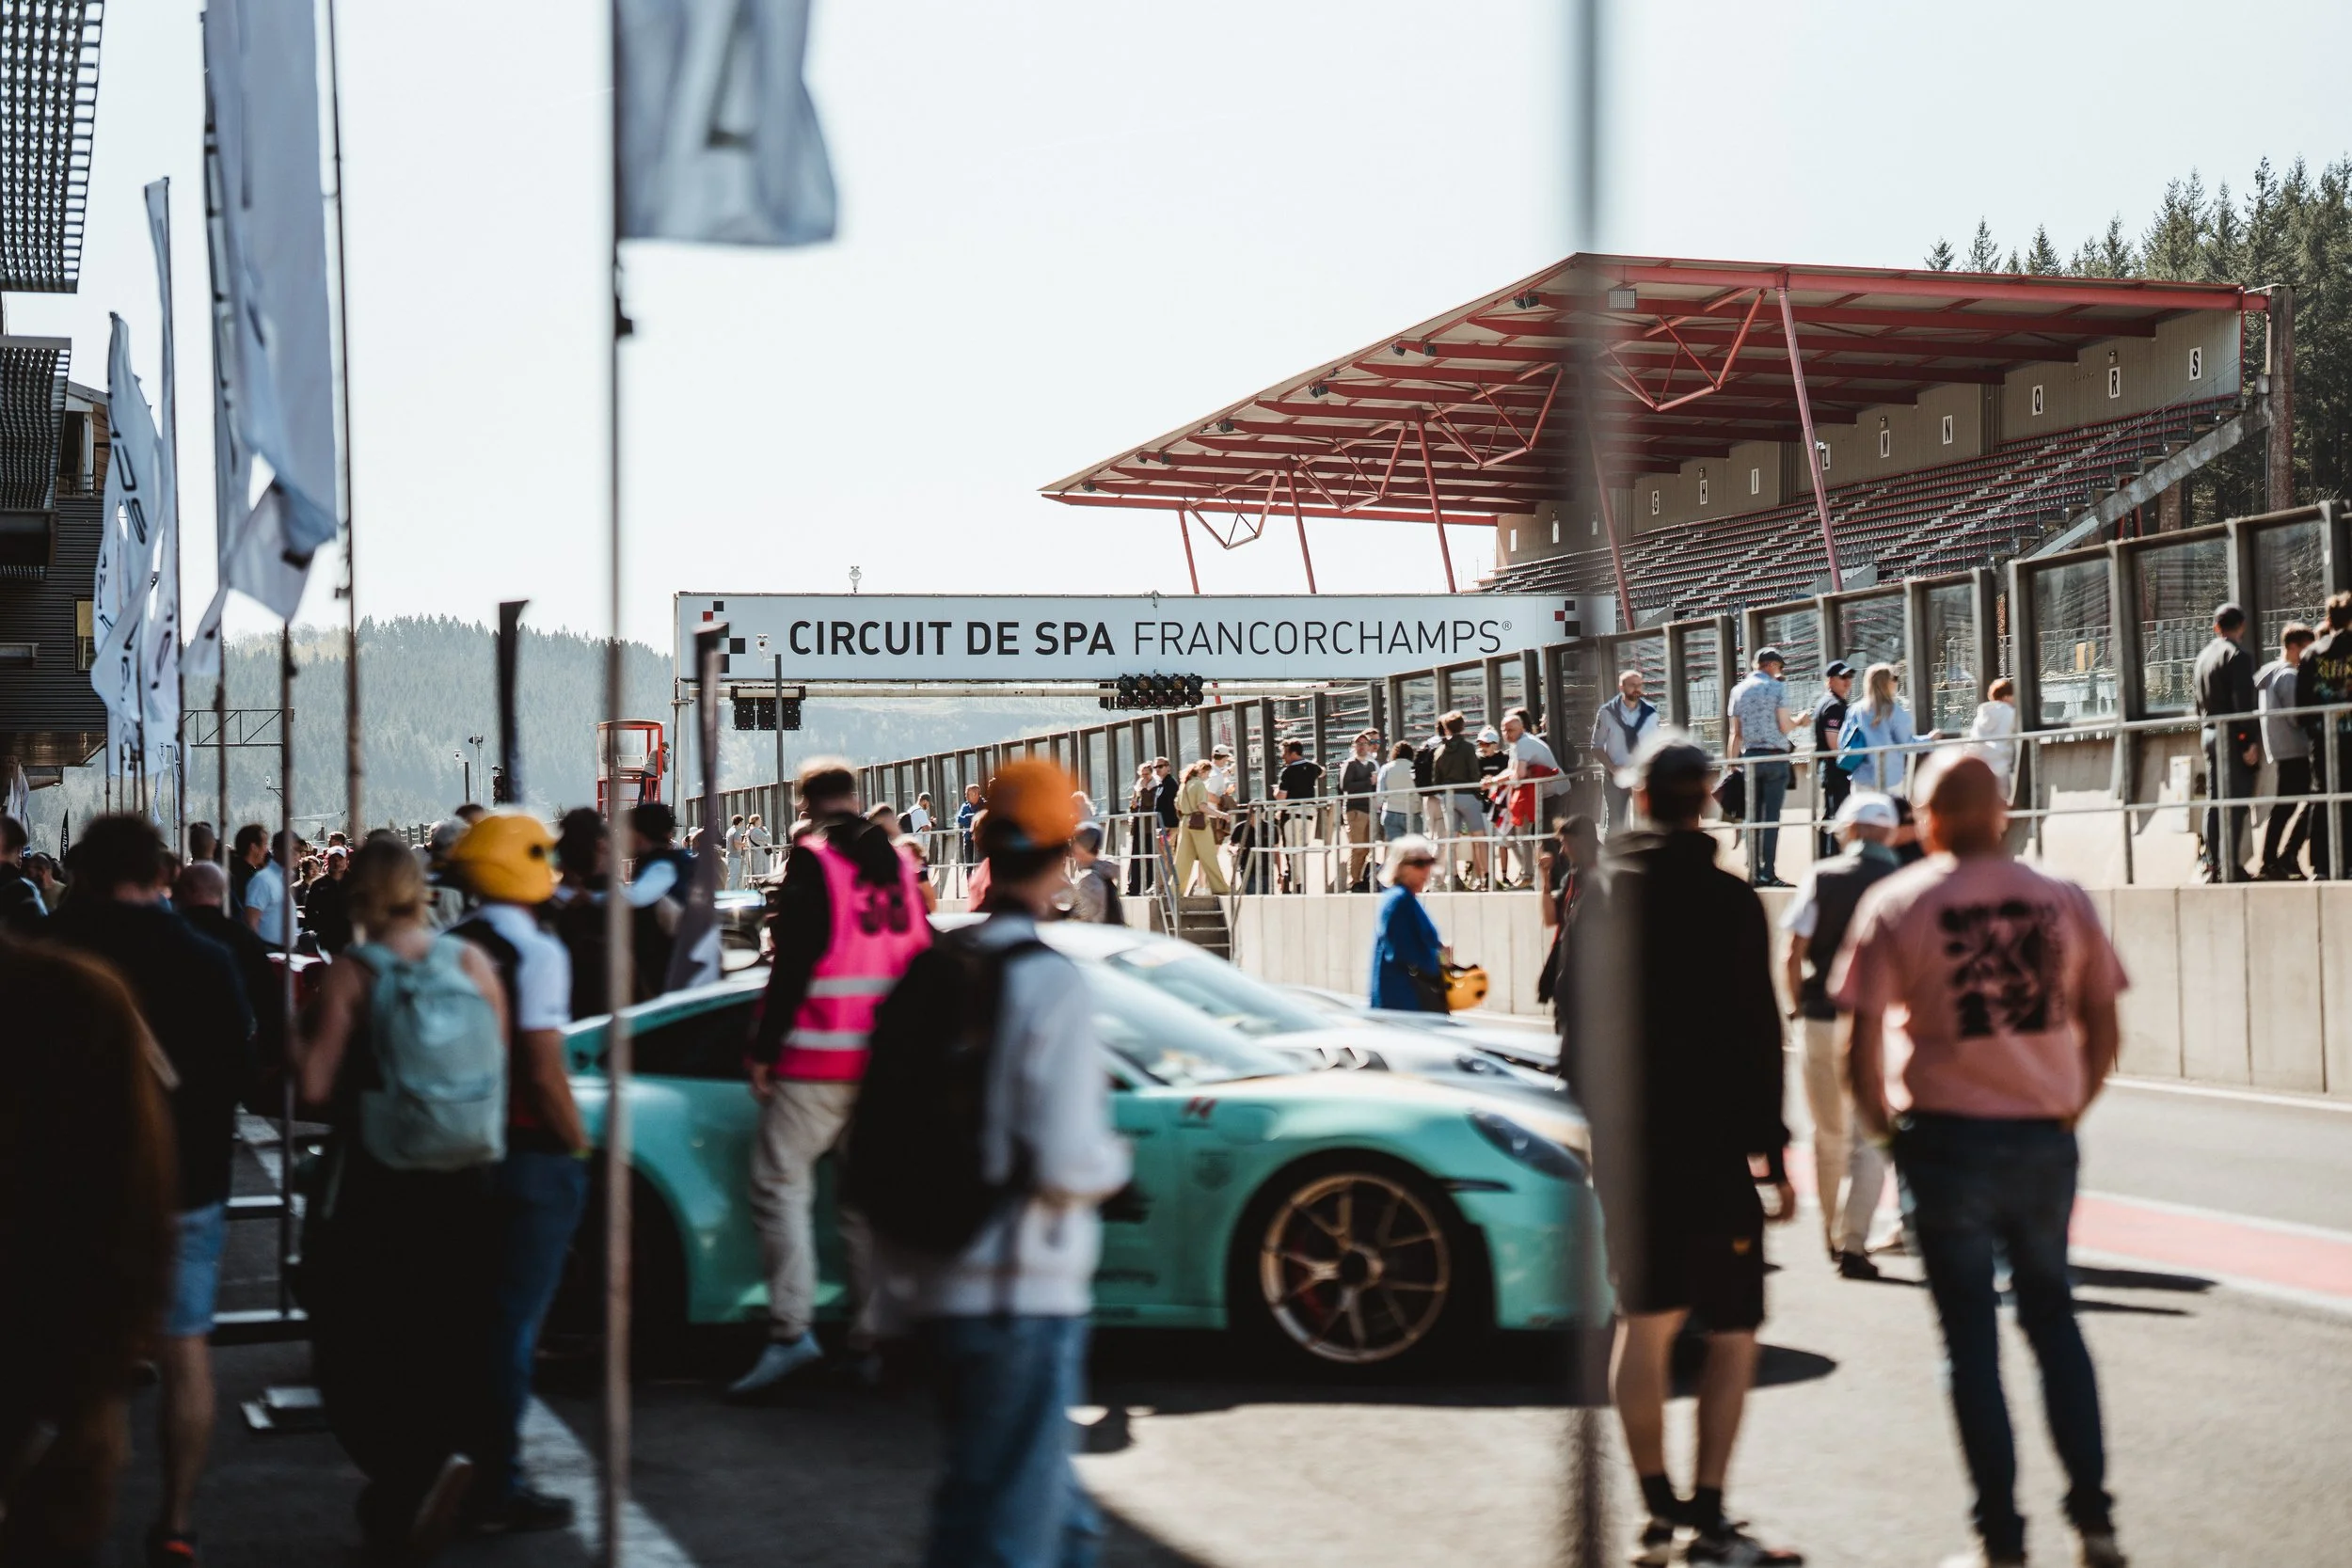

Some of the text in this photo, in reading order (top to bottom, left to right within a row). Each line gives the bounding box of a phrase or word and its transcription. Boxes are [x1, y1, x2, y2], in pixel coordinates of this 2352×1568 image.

[2192, 350, 2200, 377] S
[2111, 370, 2118, 396] R
[2034, 388, 2042, 413] Q
[1945, 418, 1951, 442] N
[789, 621, 952, 656] CIRCUIT
[967, 621, 1020, 656] DE
[1035, 621, 1116, 656] SPA
